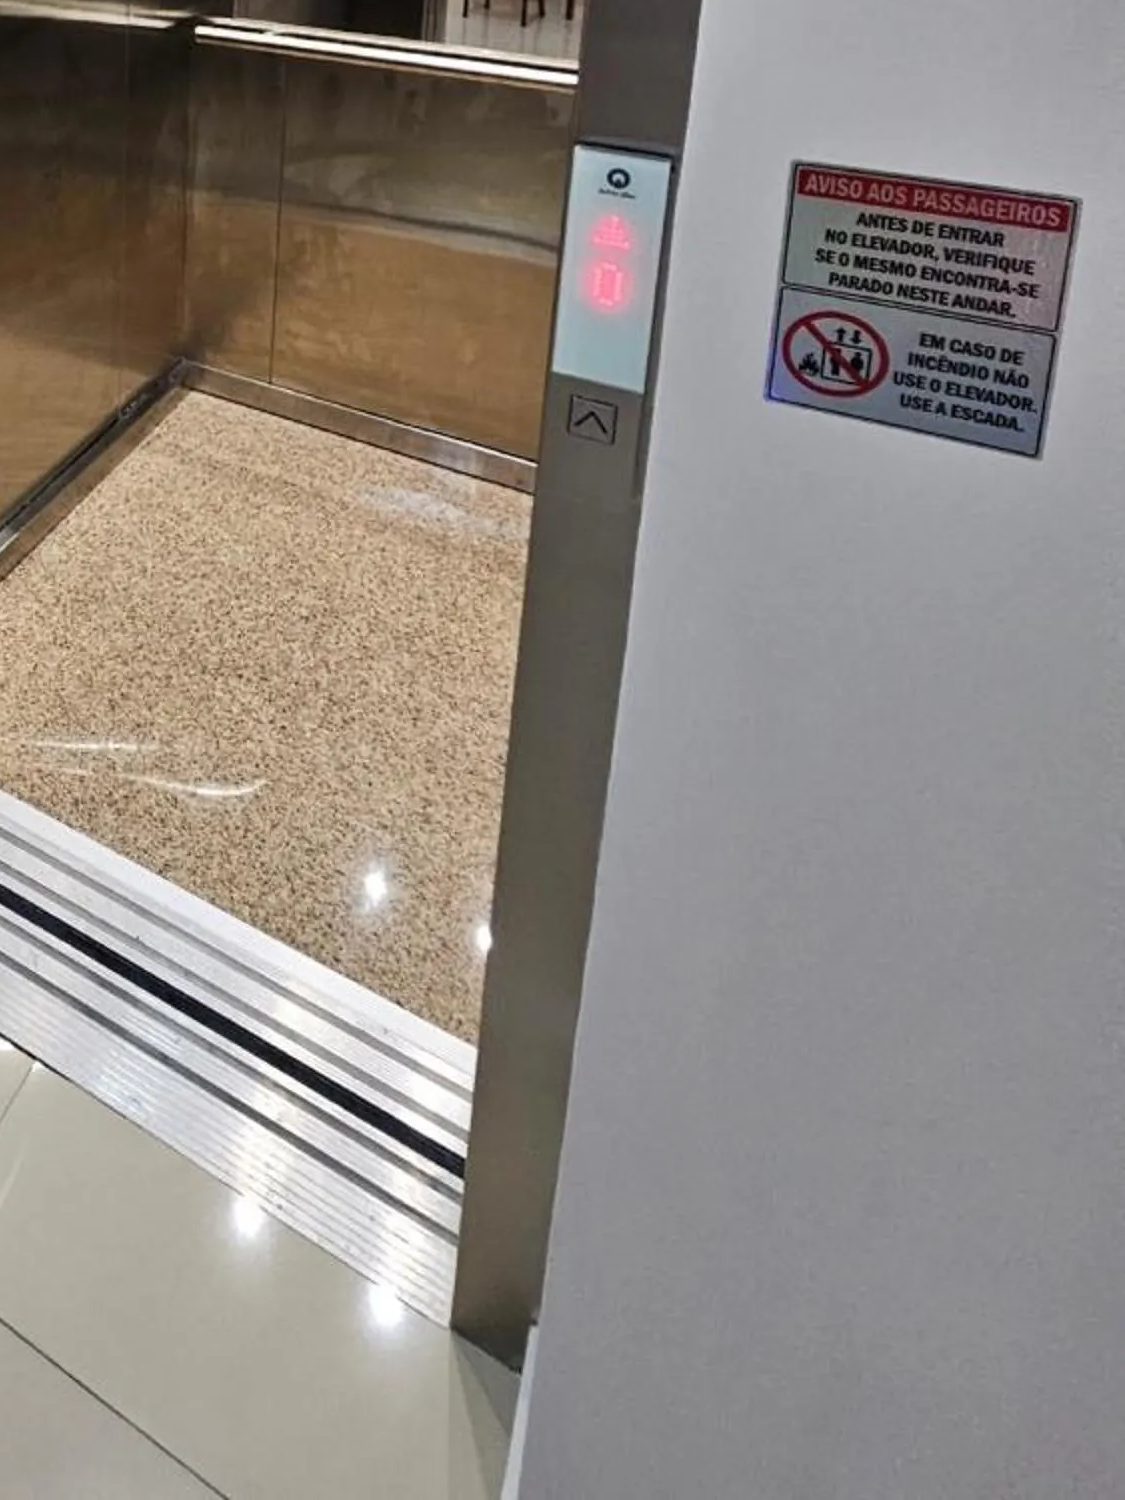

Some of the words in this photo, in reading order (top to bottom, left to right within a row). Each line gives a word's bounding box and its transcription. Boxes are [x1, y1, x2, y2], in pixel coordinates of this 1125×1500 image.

[805, 173, 863, 198] AVISO
[868, 182, 907, 205] AOS
[912, 189, 1061, 226] PASSAGEIROS
[856, 212, 909, 233] ANTES
[911, 219, 935, 238] DE
[938, 224, 1005, 247] ENTRAR
[815, 248, 836, 263] SE
[838, 253, 850, 267] O
[853, 254, 917, 278] MESMO
[921, 266, 1041, 299] ENCONTRA-SE
[825, 228, 848, 245] NO
[851, 233, 939, 262] ELEVADOR,
[943, 247, 1035, 276] VERIFIQUE
[828, 272, 894, 295] PARADO
[896, 283, 950, 306] NESTE
[951, 293, 1017, 318] ANDAR.
[907, 353, 990, 381] INCÊNDIO
[992, 366, 1029, 389] NÃO
[919, 333, 947, 351] EM
[949, 338, 996, 361] CASO
[999, 347, 1024, 366] DE
[893, 371, 927, 390] USE
[929, 378, 942, 392] O
[944, 381, 1038, 414] ELEVADOR.
[900, 393, 932, 413] USE
[934, 402, 947, 416] A
[951, 405, 1025, 432] ESCADA.
